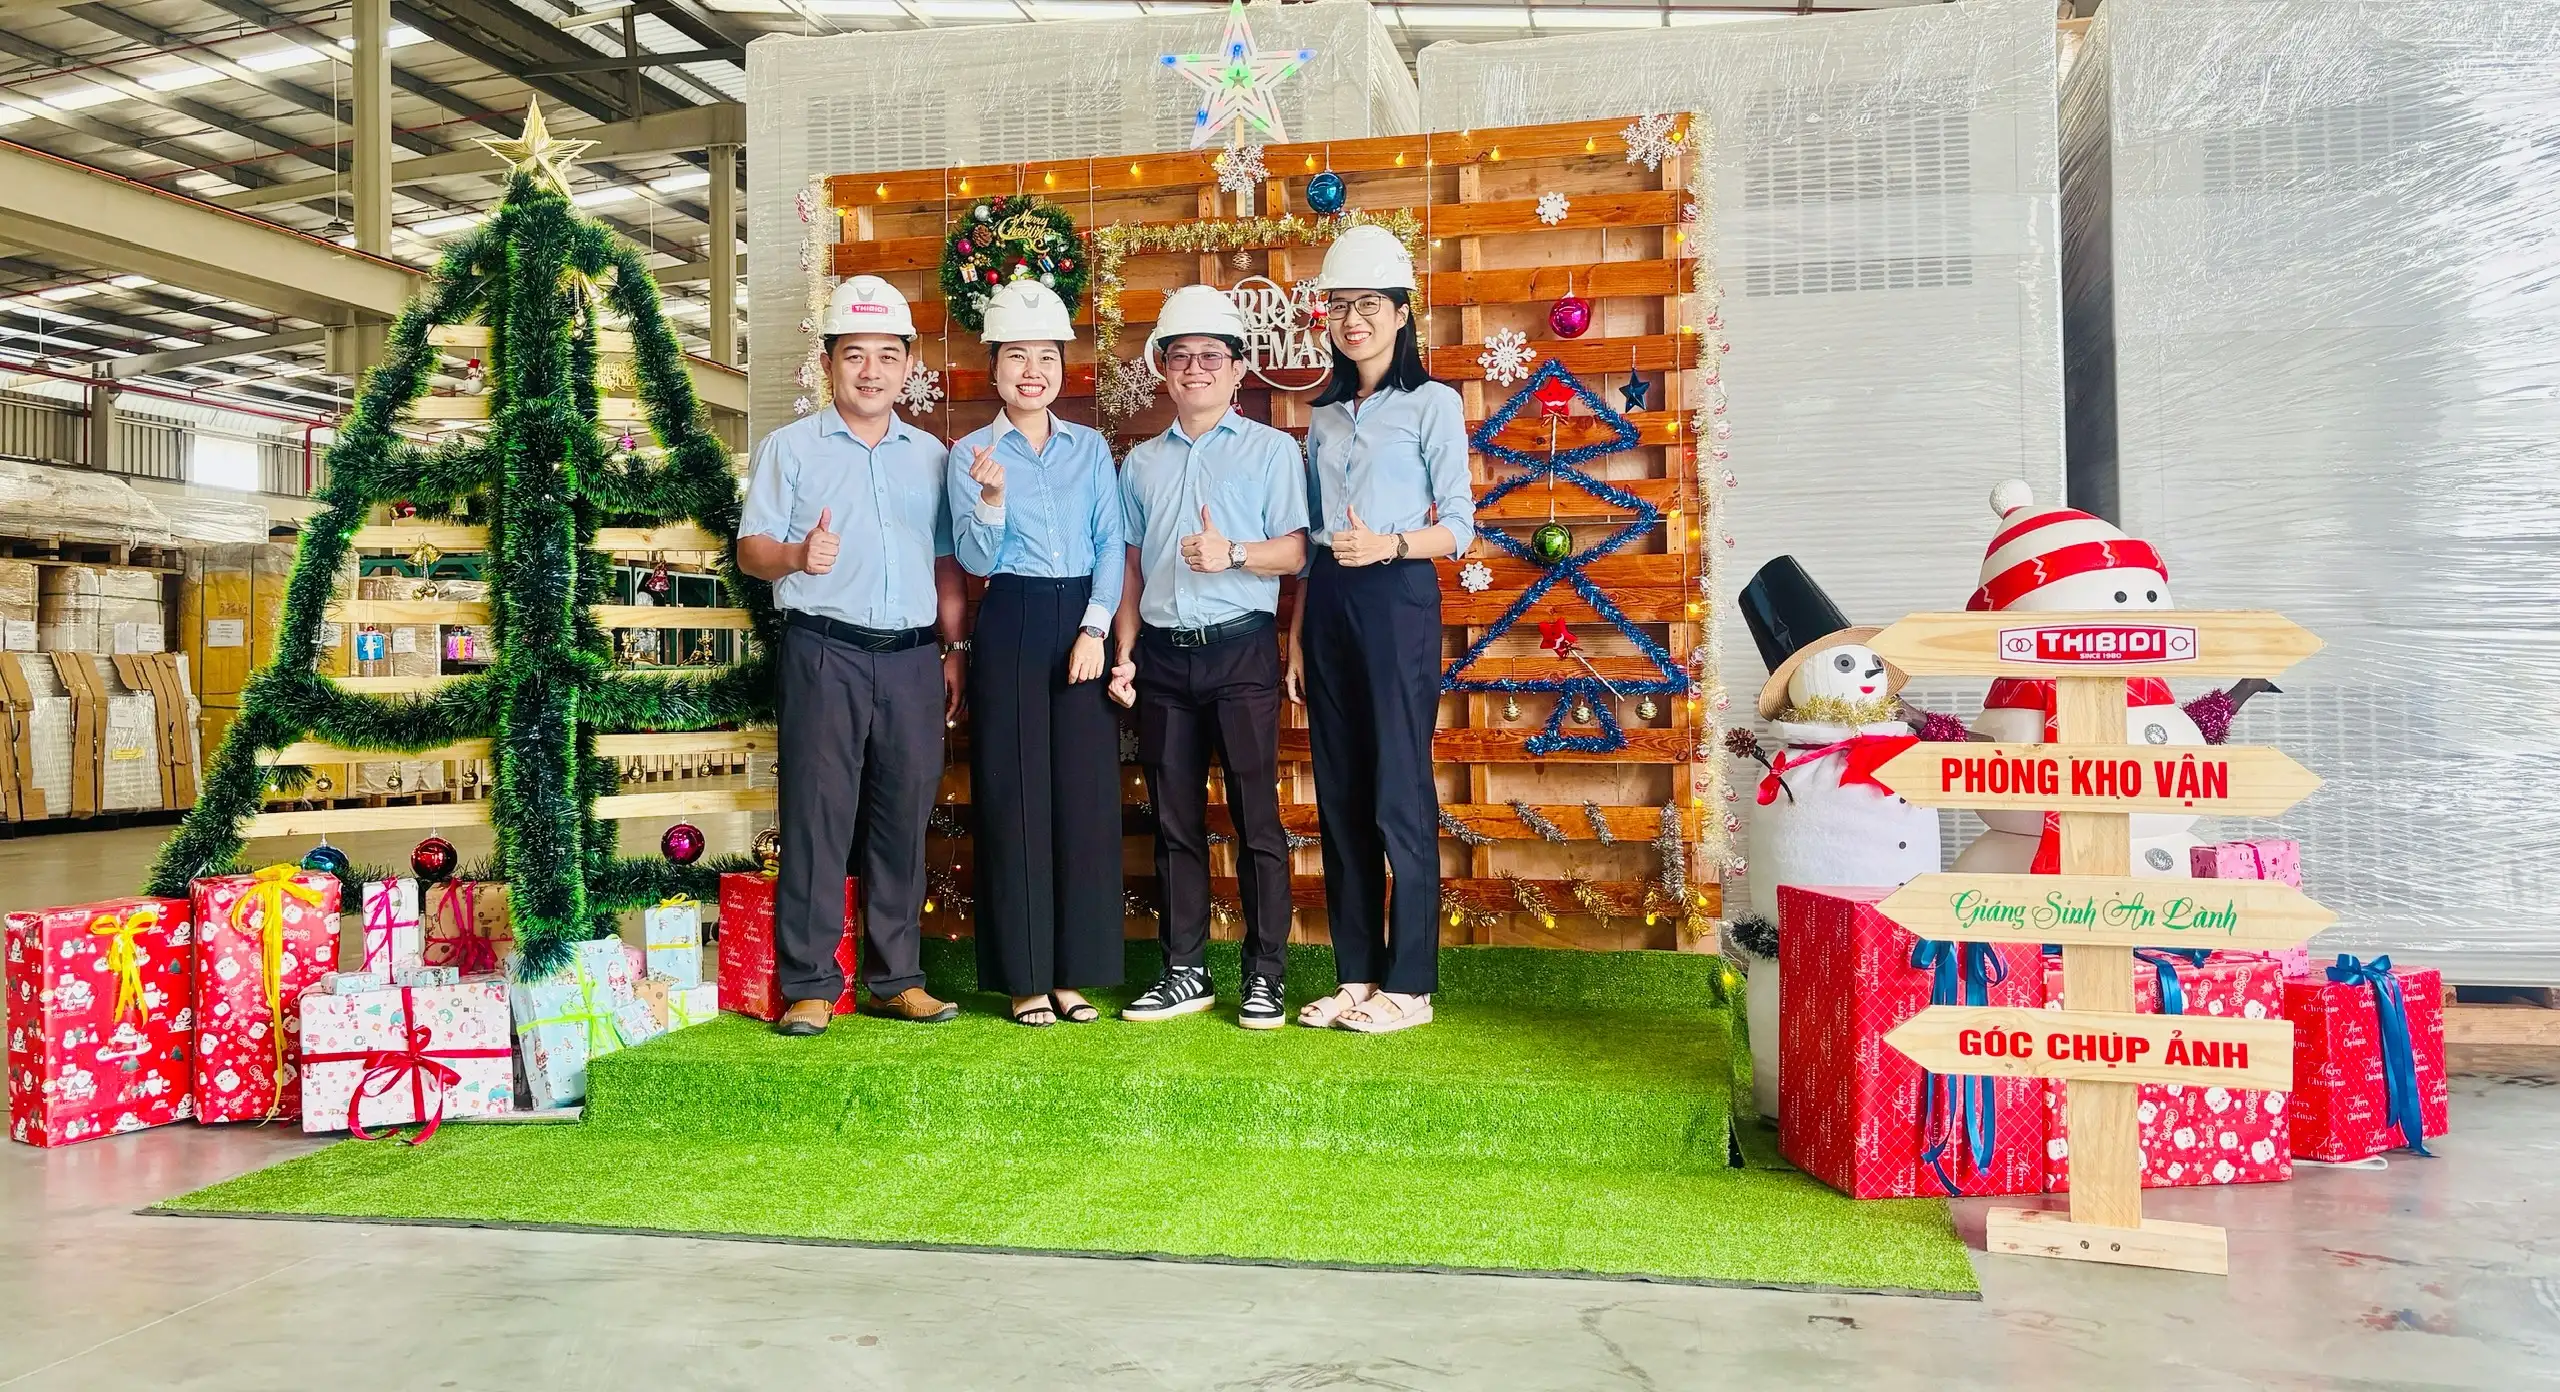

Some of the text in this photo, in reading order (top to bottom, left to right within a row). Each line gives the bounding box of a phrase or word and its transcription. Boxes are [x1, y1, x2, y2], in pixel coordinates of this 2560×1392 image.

[2042, 631, 2160, 652] THIBIDI
[1941, 750, 2229, 807] PHÒNG KHO VẬN
[1950, 889, 2238, 936] Giáng Sinh An Lành
[1854, 953, 1870, 995] Merry
[1870, 946, 1878, 992] Christmas
[1854, 1035, 1872, 1080] Merry
[1871, 1030, 1879, 1077] Christmas
[1959, 1025, 2249, 1069] GÓC CHỤP ẢNH
[1892, 1084, 1909, 1127] Merry
[1908, 1078, 1917, 1123] Christmas
[1854, 1122, 1872, 1166] Merry
[1870, 1116, 1879, 1161] Christmas
[2006, 1147, 2014, 1193] Christmas
[2014, 1143, 2031, 1187] Merry
